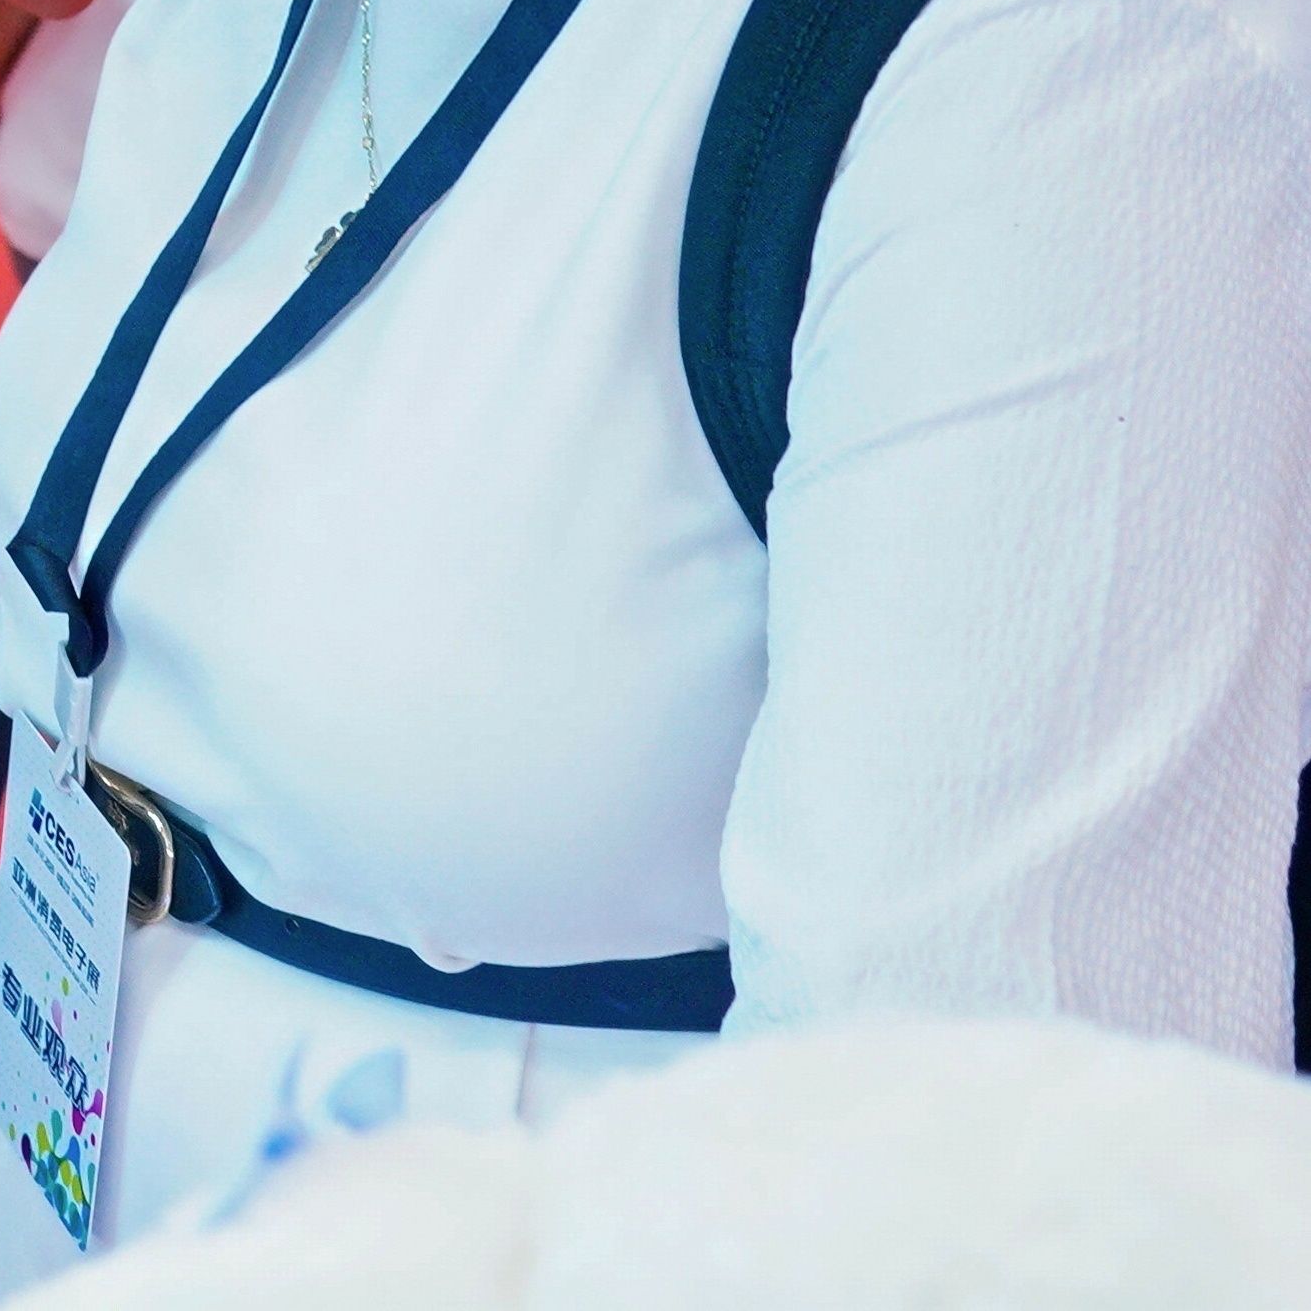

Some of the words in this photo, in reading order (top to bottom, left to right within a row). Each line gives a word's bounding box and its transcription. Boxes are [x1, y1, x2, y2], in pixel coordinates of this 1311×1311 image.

[45, 812, 75, 867] CES
[75, 852, 97, 895] Asia
[12, 856, 101, 994] 亚洲消费电子展
[1, 962, 89, 1121] 专业观众
